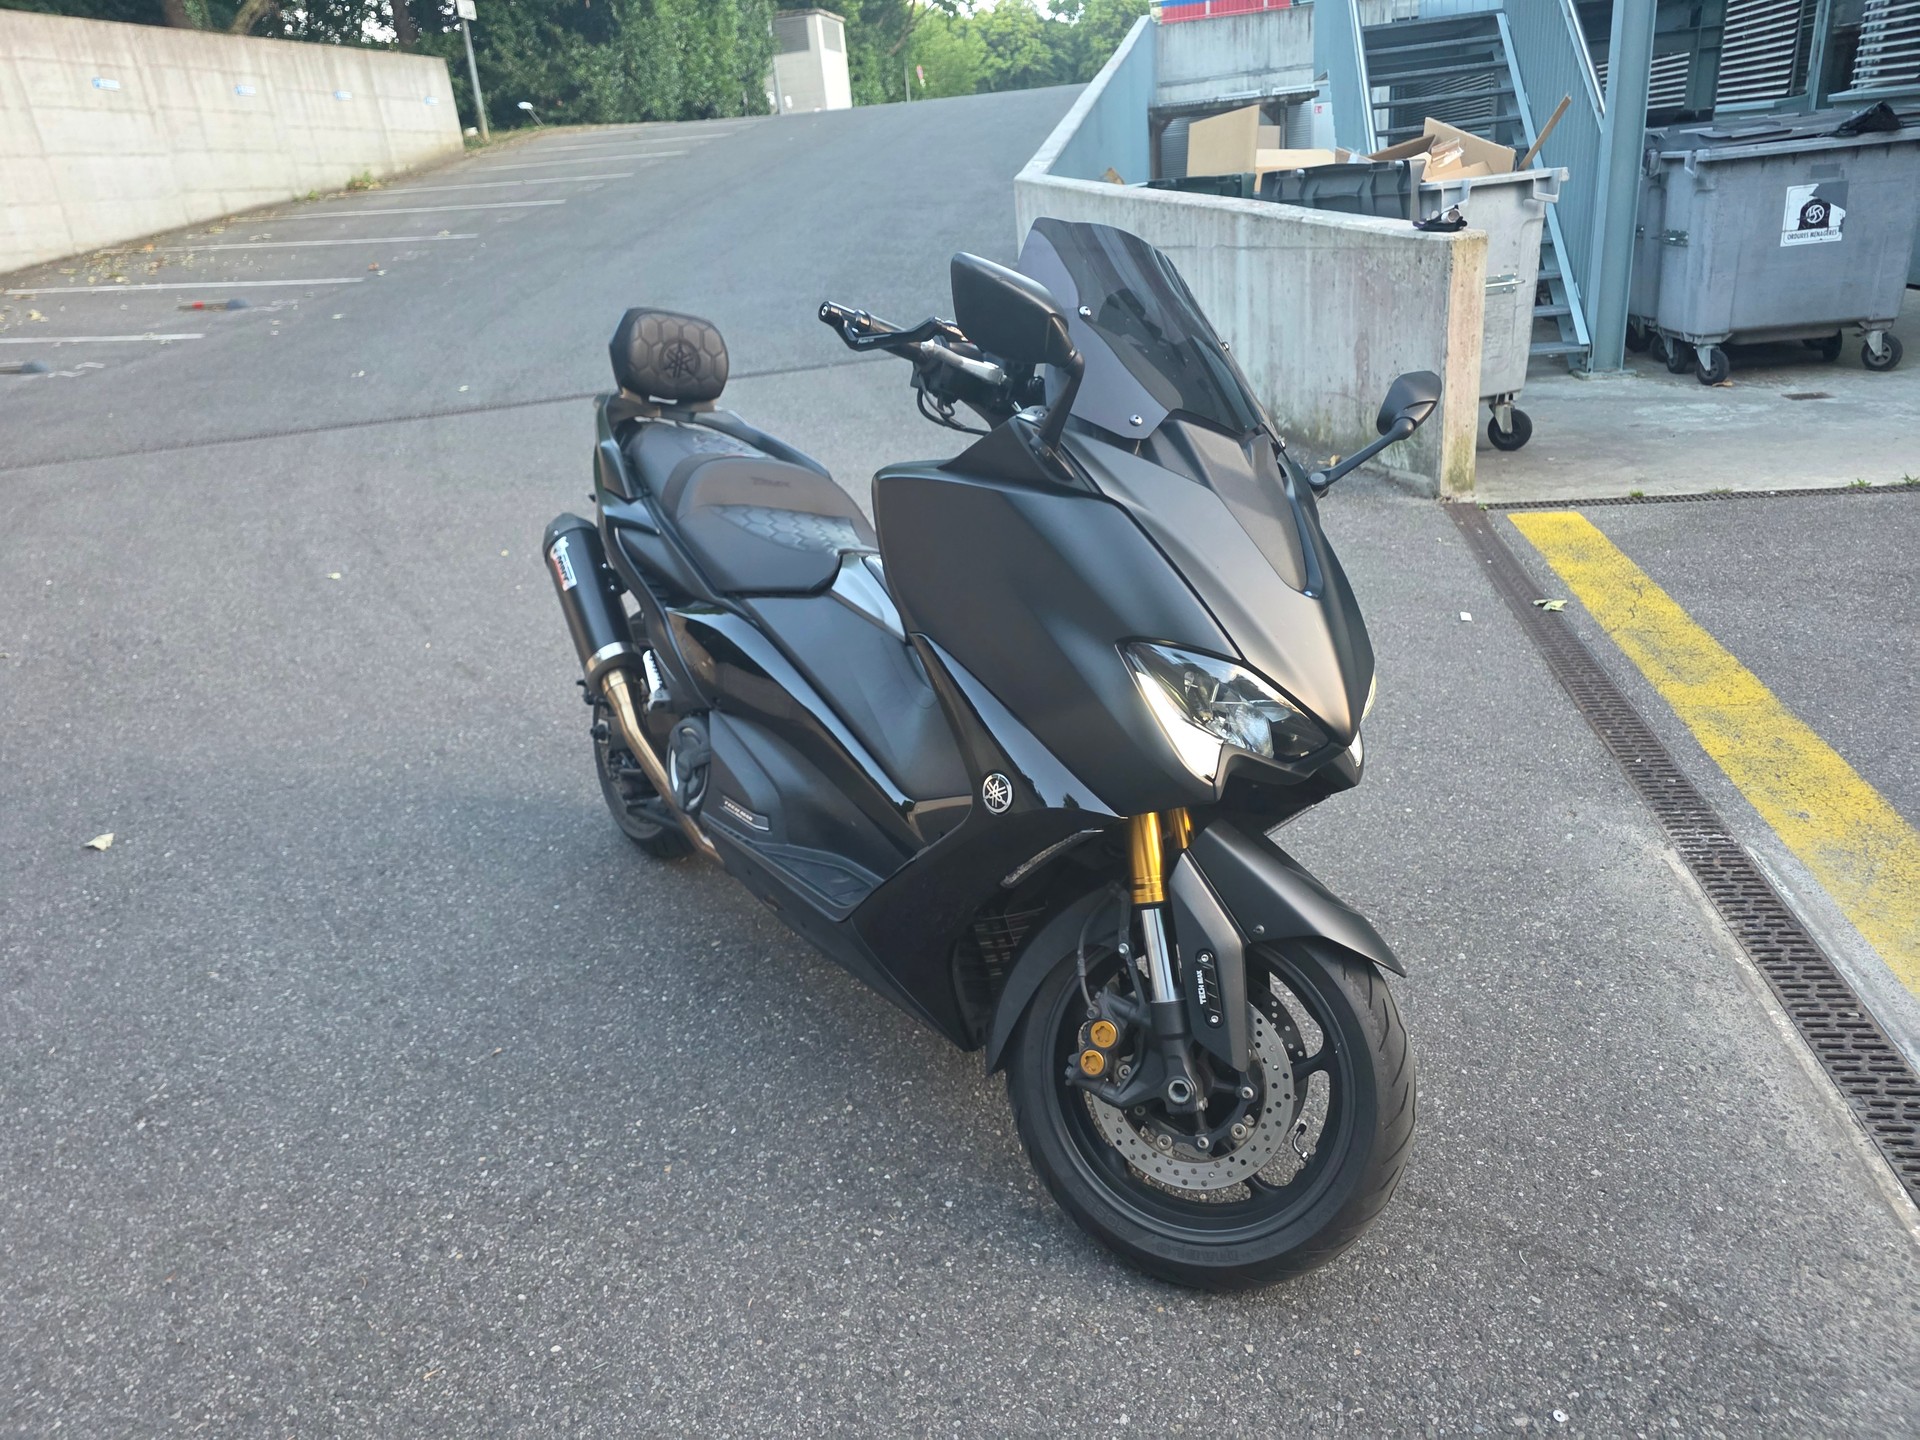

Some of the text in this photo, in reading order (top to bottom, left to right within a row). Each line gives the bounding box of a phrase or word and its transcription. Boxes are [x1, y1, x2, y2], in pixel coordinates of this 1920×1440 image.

[1787, 231, 1809, 240] ORDURES
[1196, 970, 1207, 1004] TECH MAX
